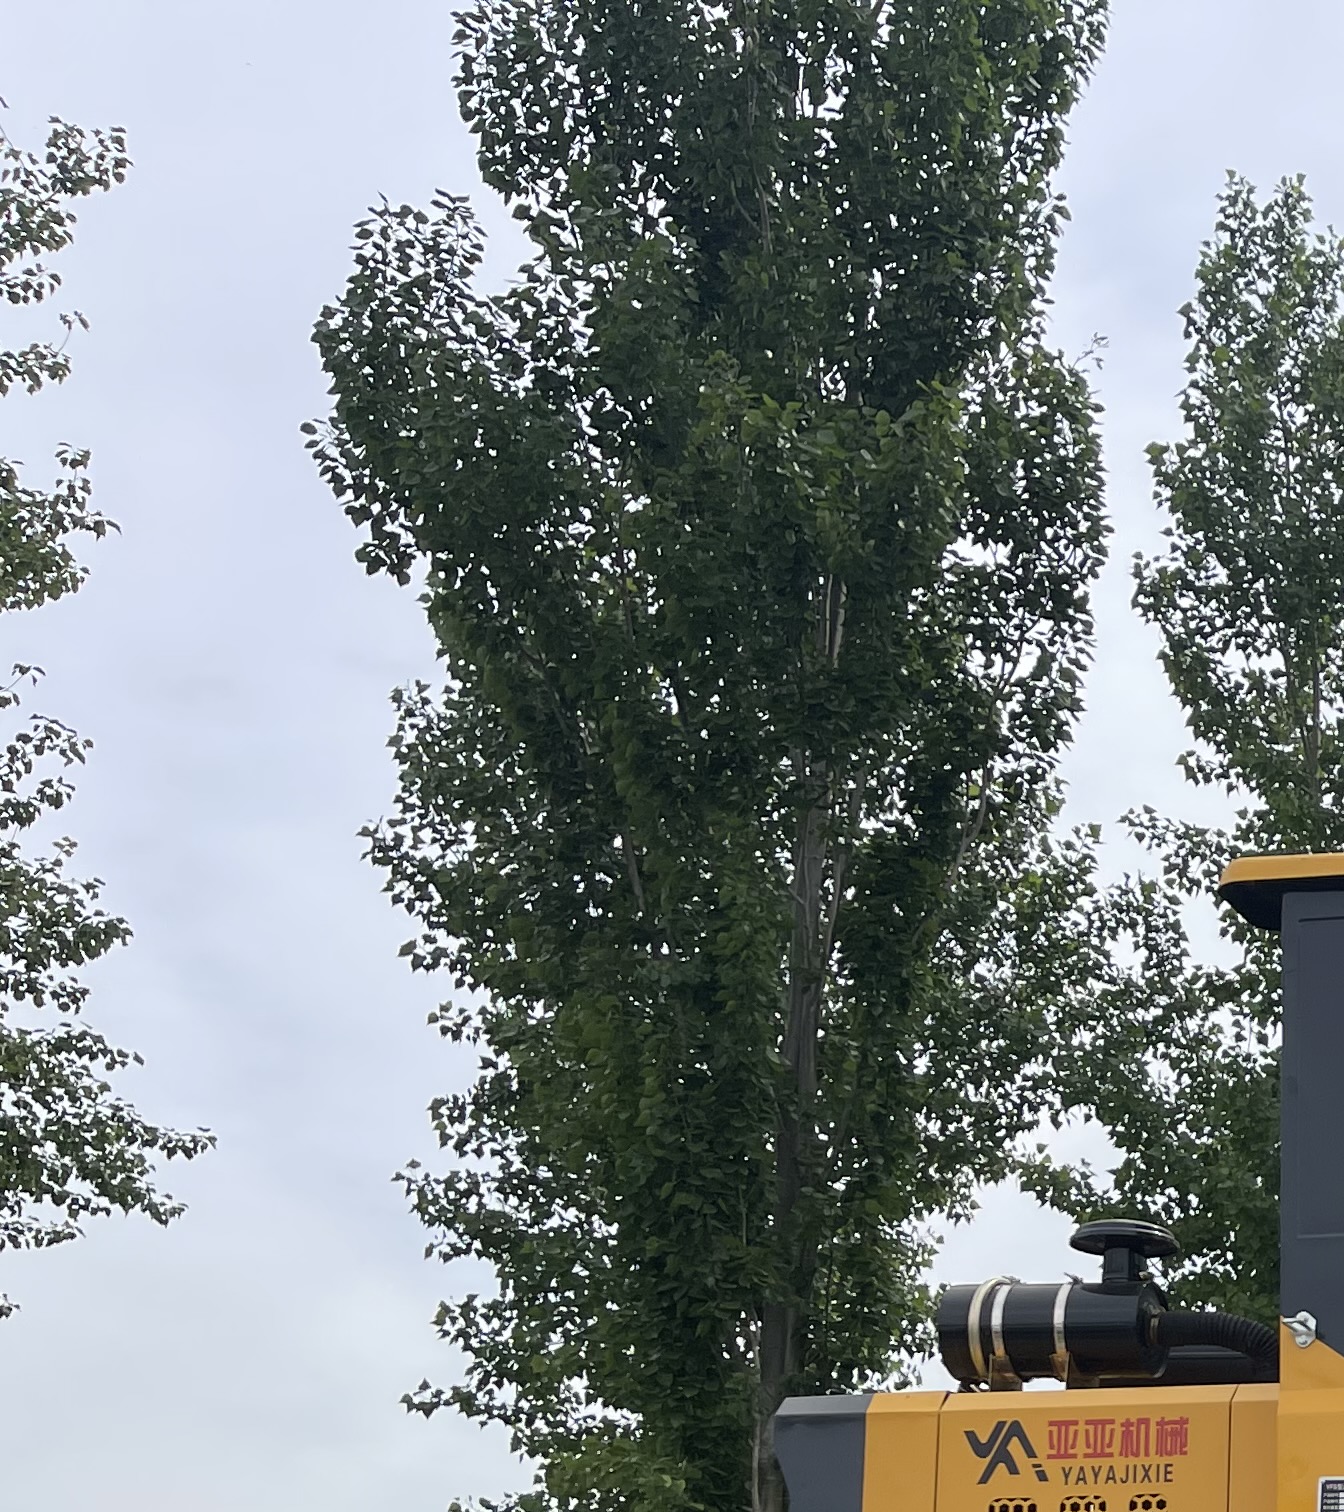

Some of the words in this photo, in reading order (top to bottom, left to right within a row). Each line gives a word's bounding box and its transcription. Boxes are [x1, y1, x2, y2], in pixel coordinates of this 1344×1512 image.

[1046, 1416, 1189, 1460] 亚亚机械
[1061, 1463, 1174, 1486] YAYAJIXIE
